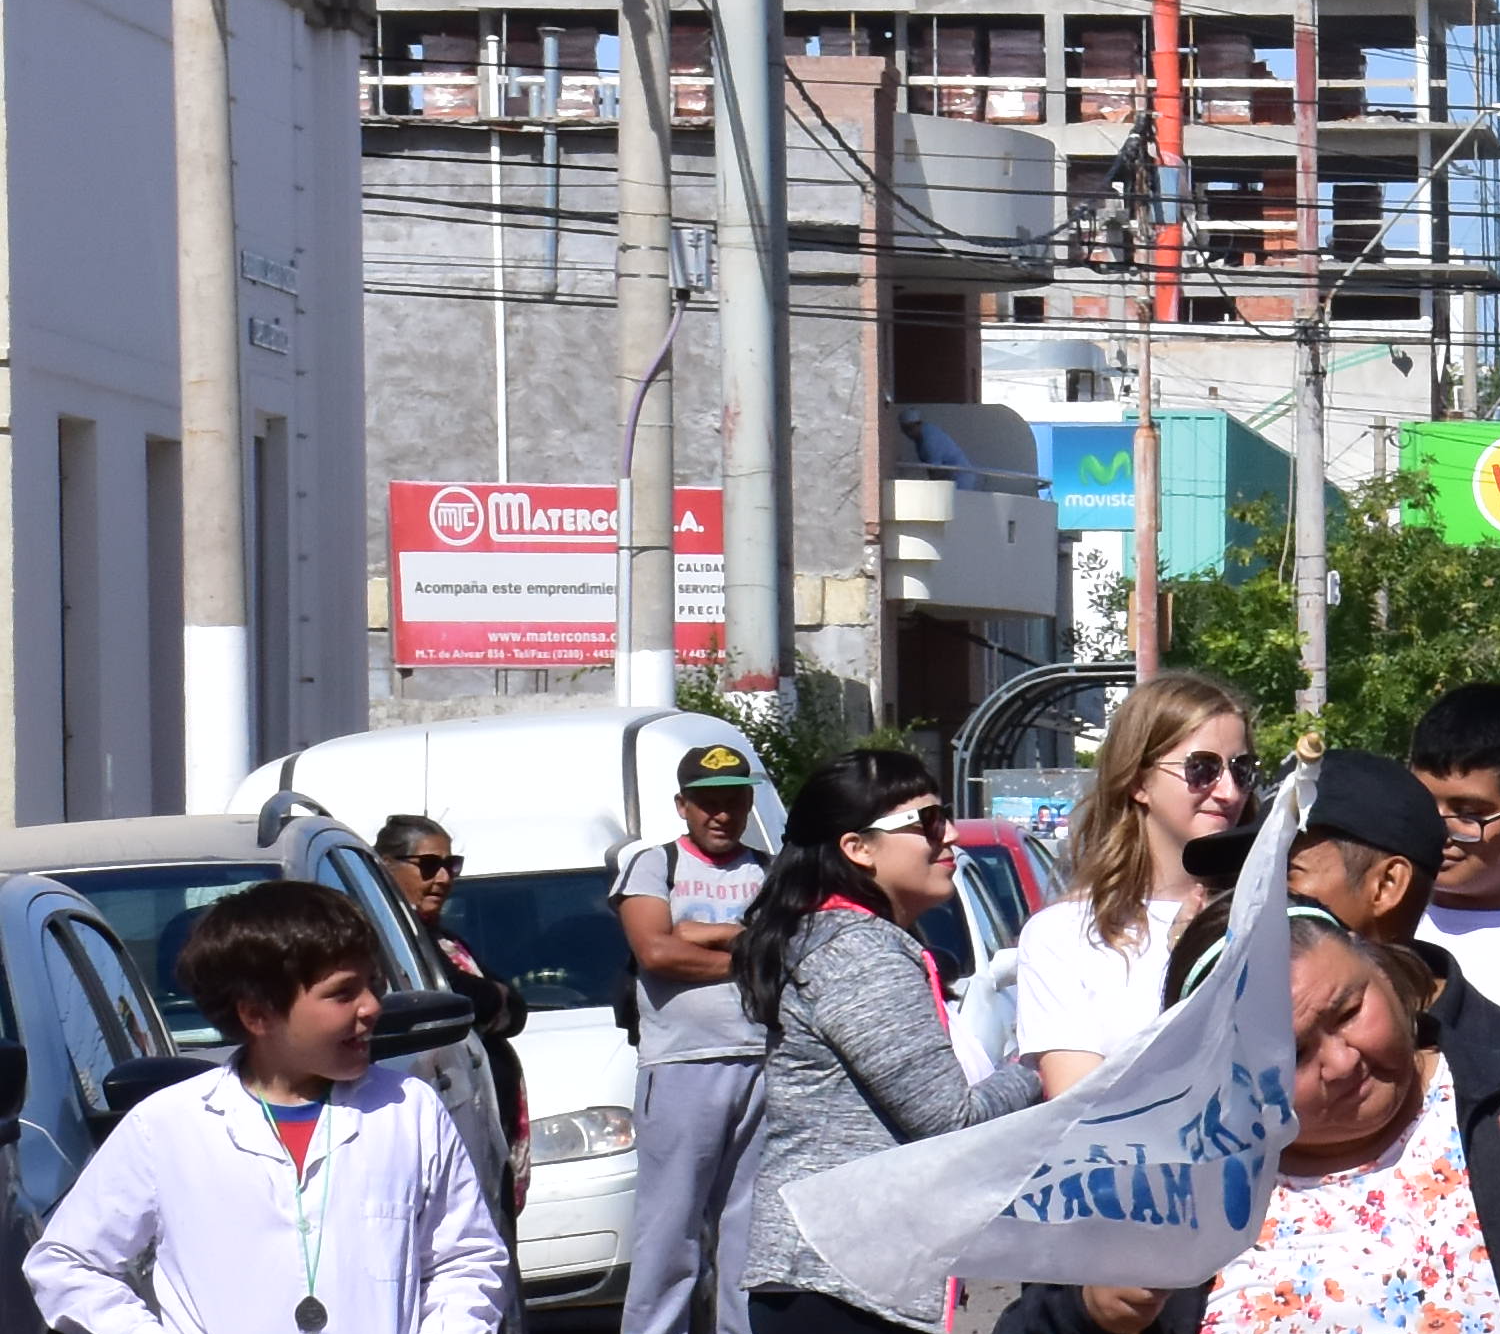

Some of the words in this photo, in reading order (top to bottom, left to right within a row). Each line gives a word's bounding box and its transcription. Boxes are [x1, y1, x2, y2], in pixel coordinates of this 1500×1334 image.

[1065, 493, 1136, 508] movista
[488, 493, 618, 543] MATERC
[414, 580, 488, 597] Acompaña
[492, 583, 521, 595] este
[526, 581, 617, 597] emprendimie
[488, 631, 617, 643] www.materconsa.c
